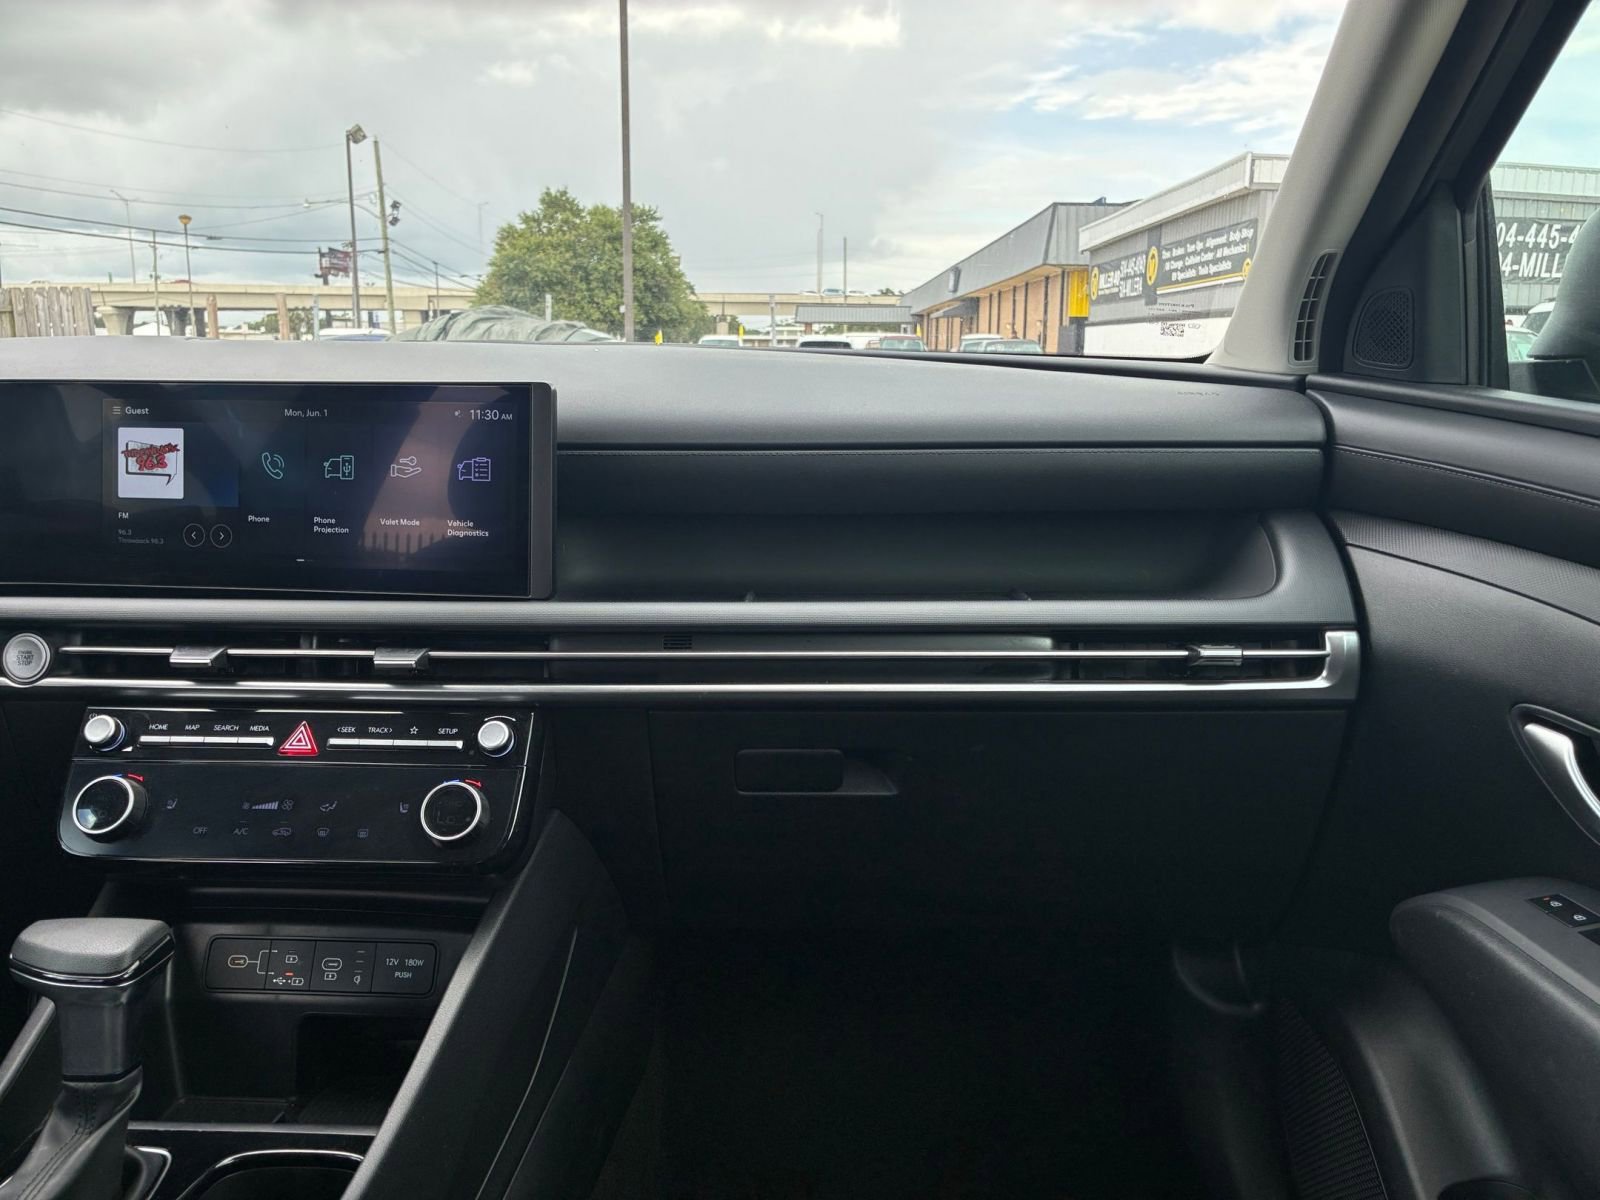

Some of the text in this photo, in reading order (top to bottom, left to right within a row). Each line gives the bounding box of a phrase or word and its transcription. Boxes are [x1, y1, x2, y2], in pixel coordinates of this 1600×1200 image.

[1499, 252, 1562, 278] 4-MILL
[125, 406, 149, 415] Guest
[284, 408, 305, 417] Mon,
[306, 408, 323, 417] Jun.
[469, 409, 499, 420] 11:30
[248, 515, 270, 523] Phone
[313, 517, 336, 525] Phone
[380, 518, 420, 526] Valet Mode
[447, 520, 474, 528] Vehicle
[313, 526, 349, 534] Projection
[447, 529, 489, 538] Diagnostics
[213, 724, 239, 732] SEARCH
[438, 727, 459, 735] SETUP
[233, 827, 249, 836] A/C
[385, 957, 424, 967] 12V 180W
[394, 971, 412, 979] PUSH
